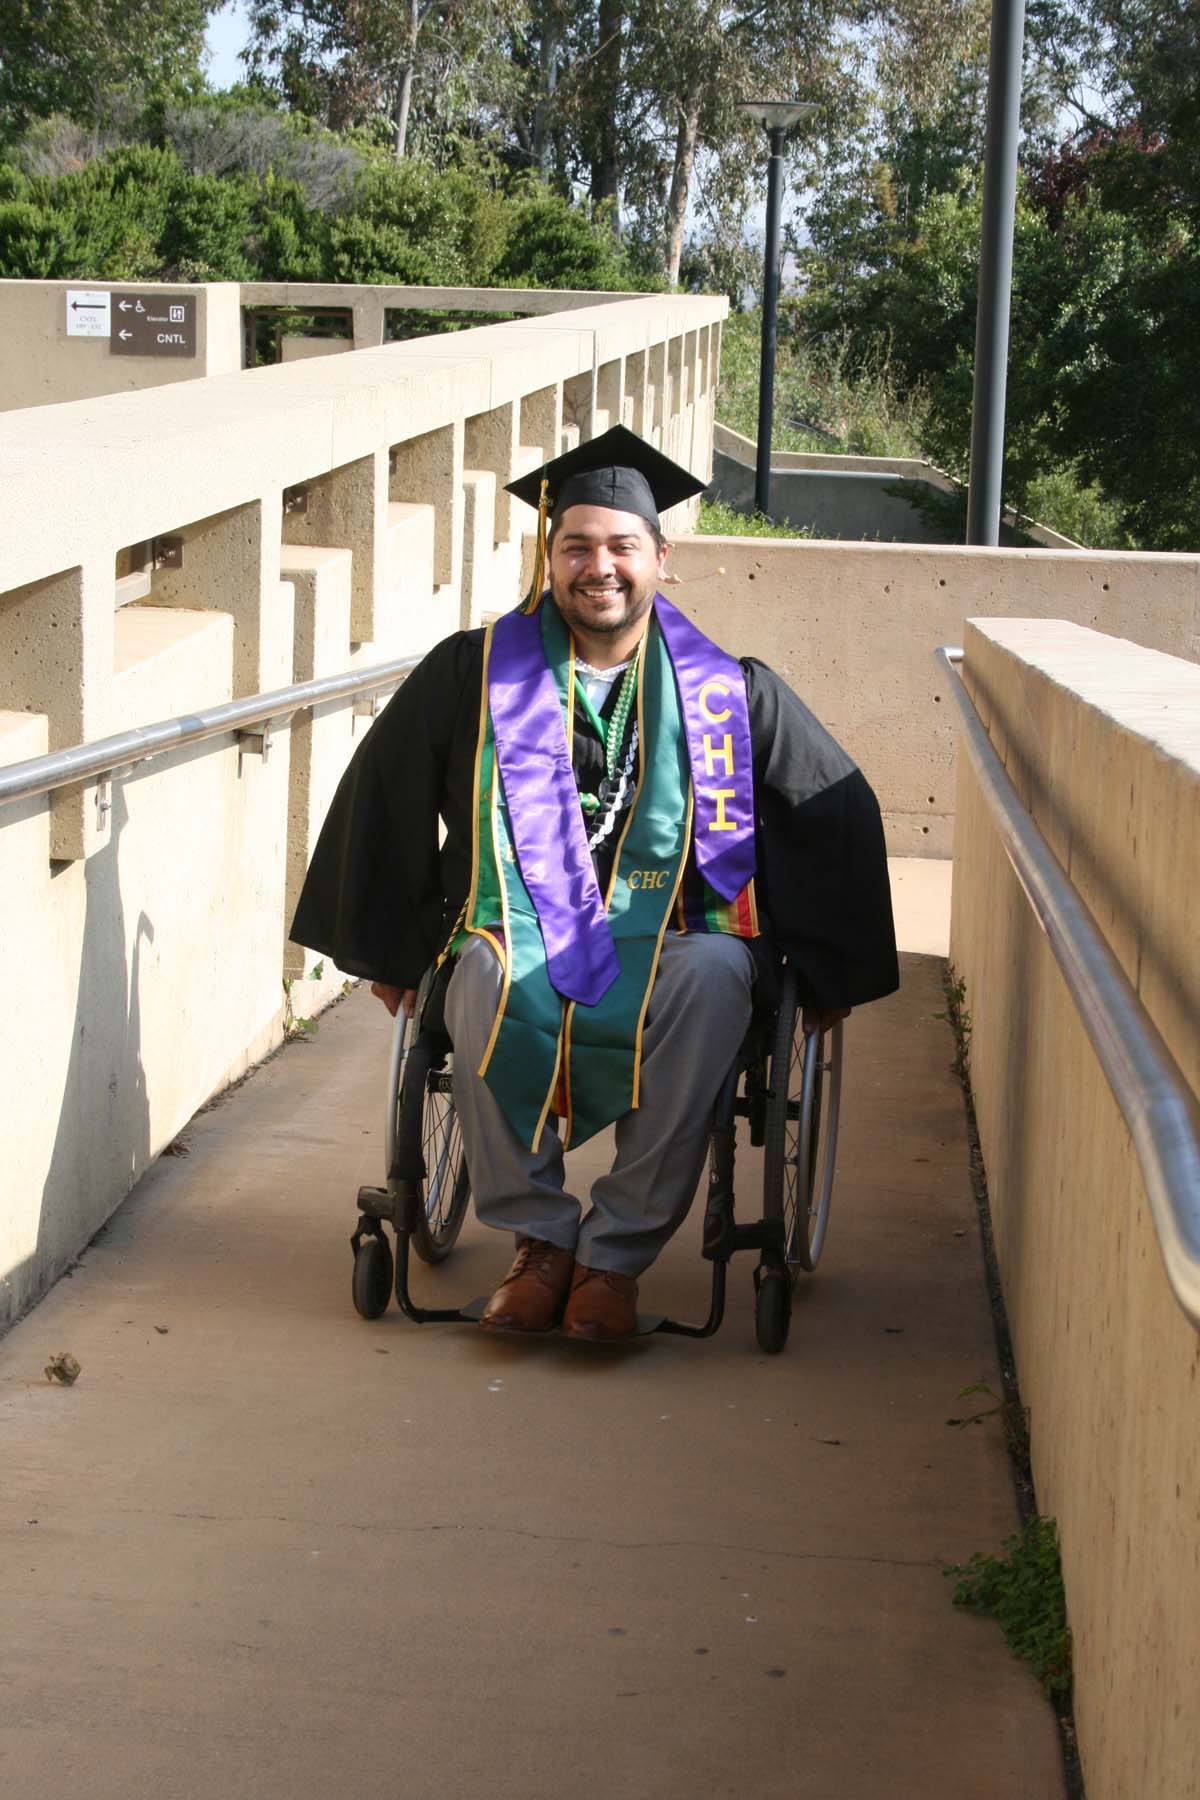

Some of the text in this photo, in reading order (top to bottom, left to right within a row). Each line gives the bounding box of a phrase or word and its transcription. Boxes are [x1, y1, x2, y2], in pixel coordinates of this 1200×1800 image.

[157, 333, 186, 344] CNTL
[698, 680, 738, 832] CHI
[626, 869, 671, 890] CHC
